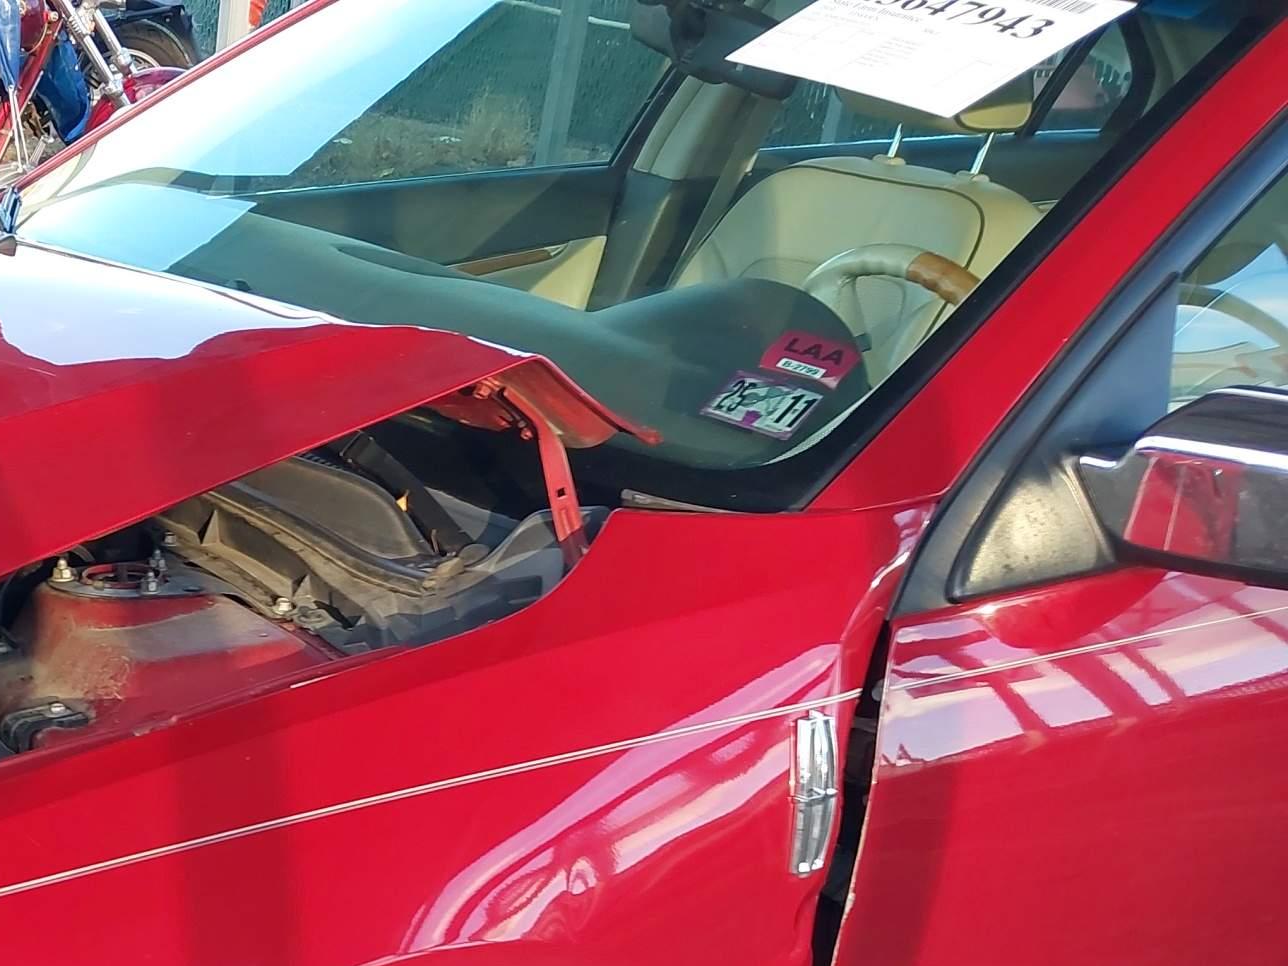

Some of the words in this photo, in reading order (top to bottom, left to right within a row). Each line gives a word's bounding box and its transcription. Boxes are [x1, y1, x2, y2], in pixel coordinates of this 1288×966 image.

[783, 337, 845, 366] LAA
[713, 379, 757, 412] 25
[774, 394, 818, 428] 11
